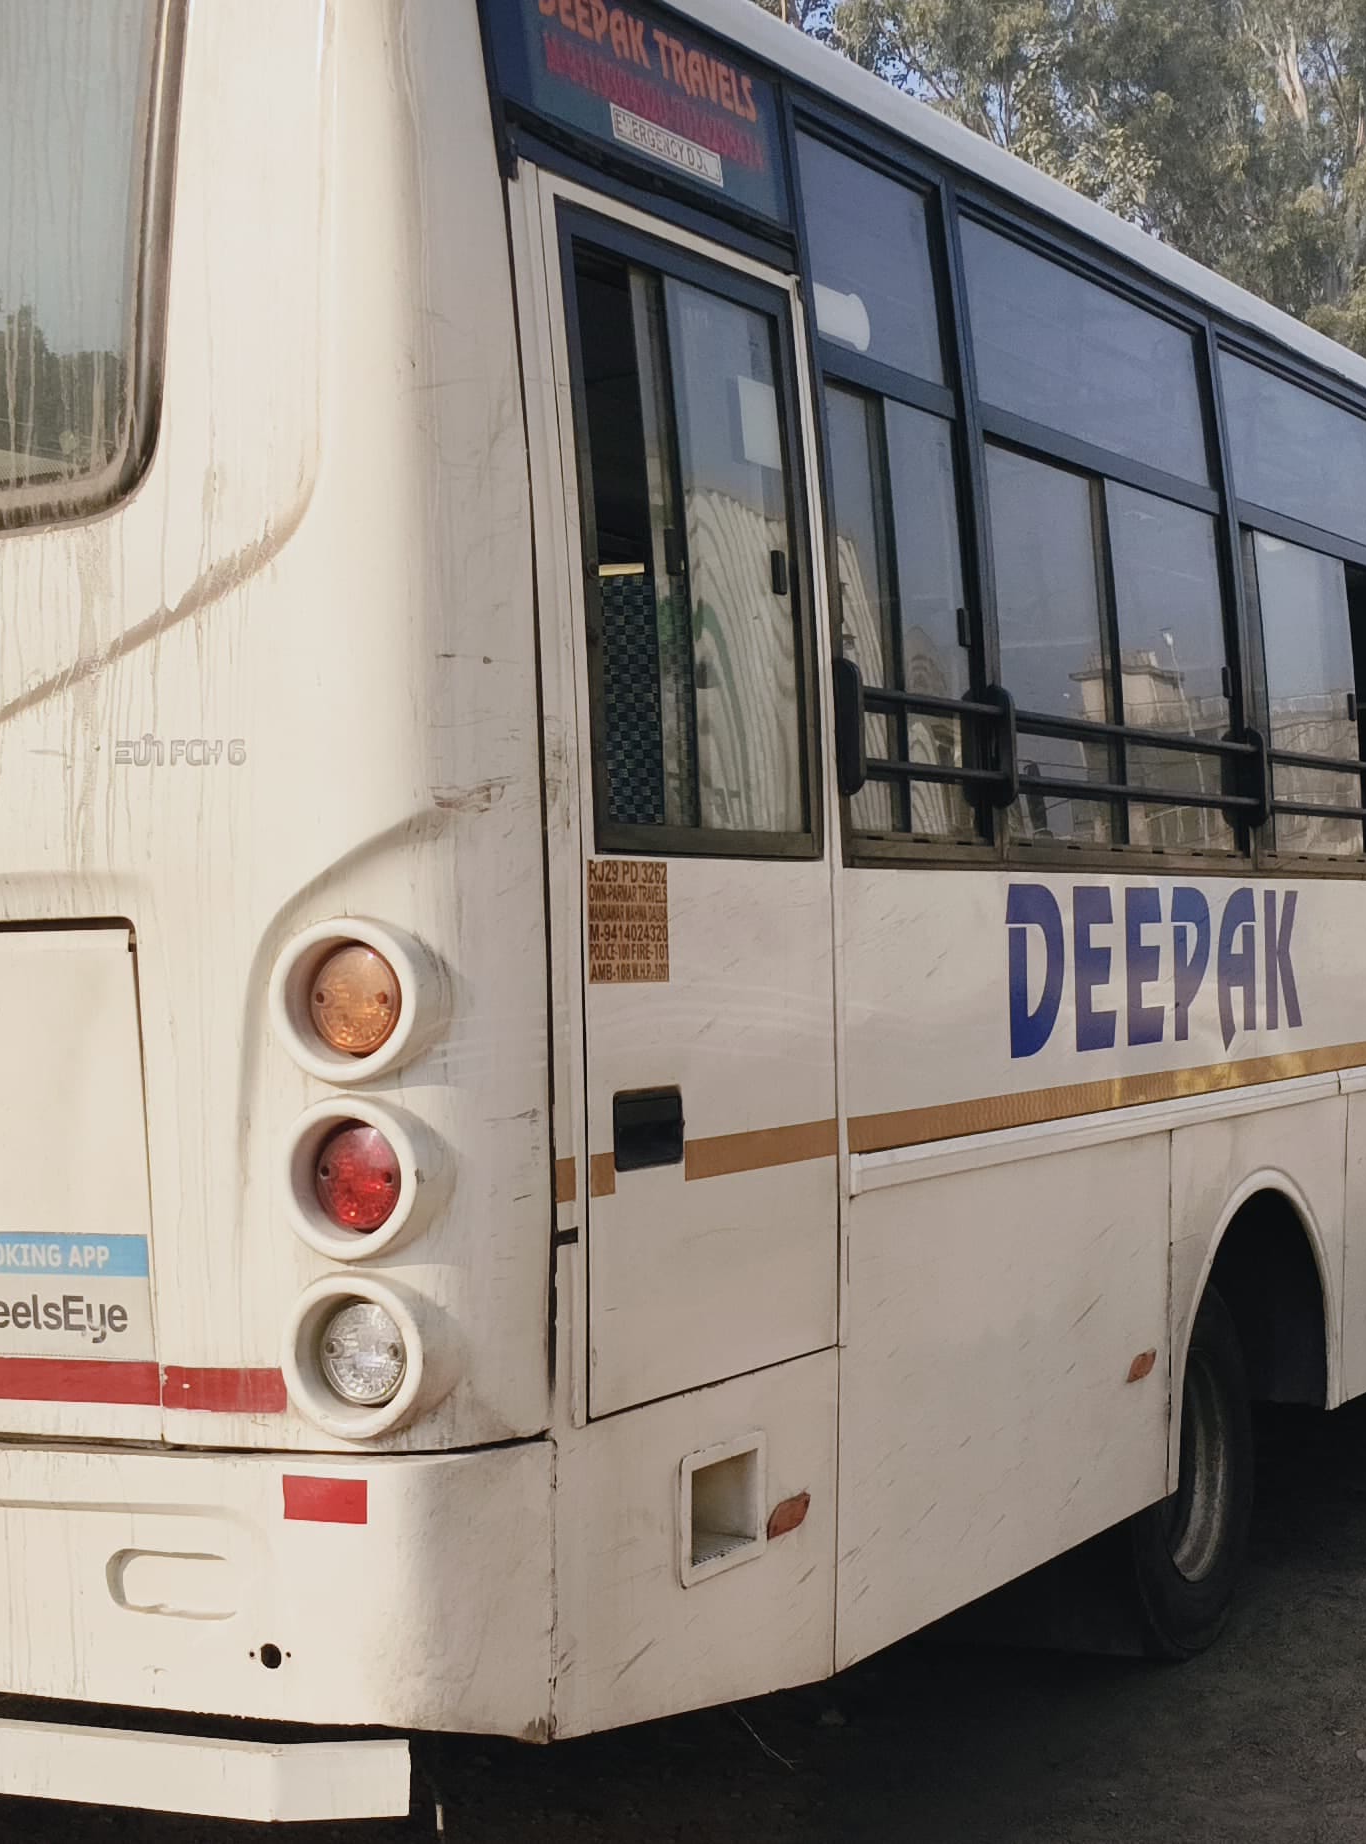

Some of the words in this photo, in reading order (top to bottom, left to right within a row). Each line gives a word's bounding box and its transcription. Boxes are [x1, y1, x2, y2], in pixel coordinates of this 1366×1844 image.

[653, 28, 757, 124] TRAVELS
[588, 861, 619, 883] RJ29
[623, 862, 639, 883] PD
[641, 862, 667, 884] 3262
[638, 885, 667, 903] TRAVELS
[589, 924, 668, 942] M-9414024320
[1006, 884, 1302, 1059] DEEPAK
[68, 1244, 110, 1269] APP
